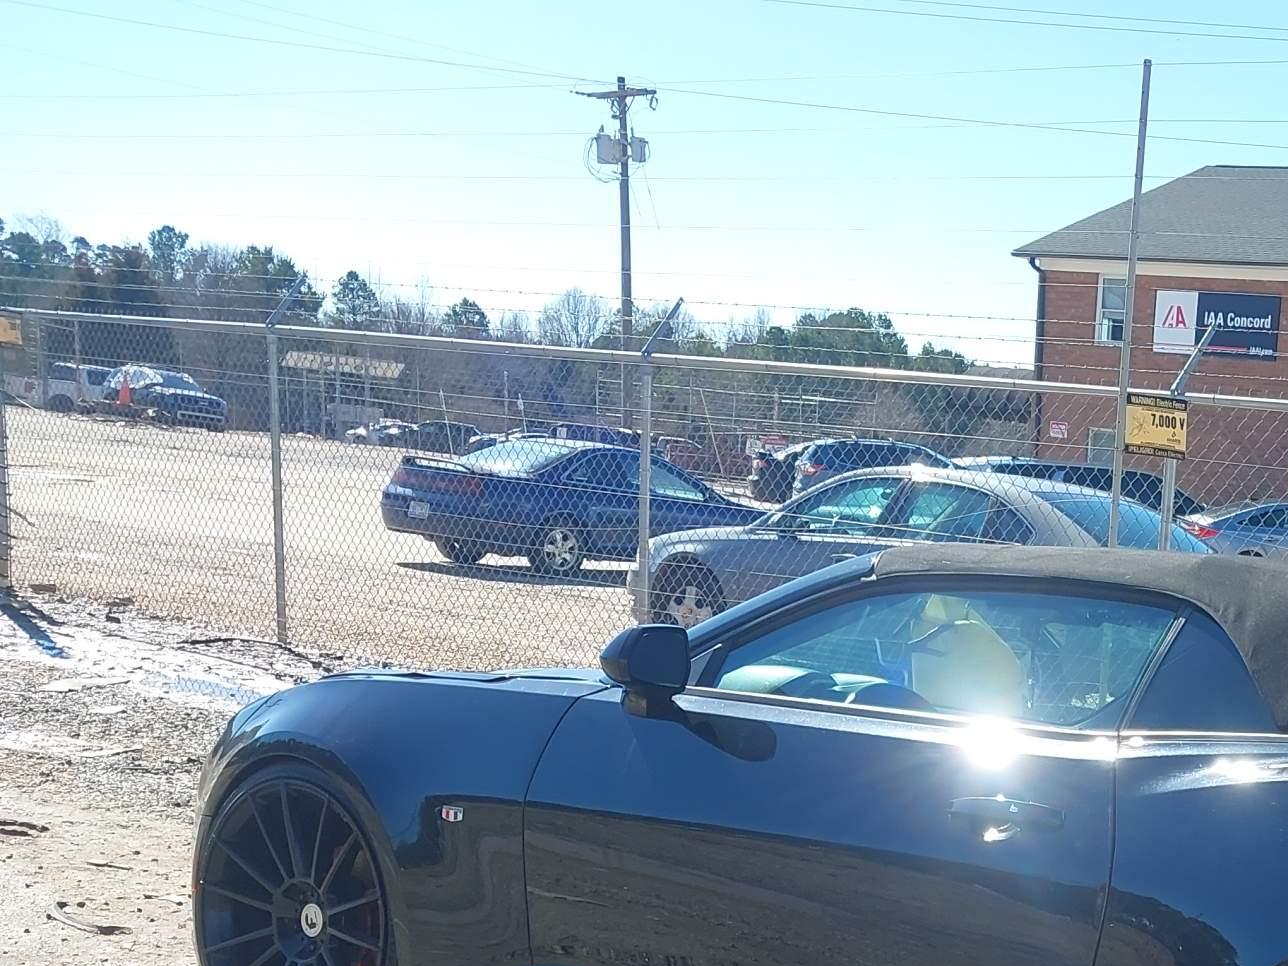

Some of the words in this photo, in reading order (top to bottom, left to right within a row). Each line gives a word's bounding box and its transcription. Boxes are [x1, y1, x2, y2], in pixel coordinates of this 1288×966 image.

[1204, 311, 1225, 327] IAA
[1226, 312, 1272, 329] Concord
[1151, 413, 1177, 430] 7,000
[1179, 416, 1186, 431] V
